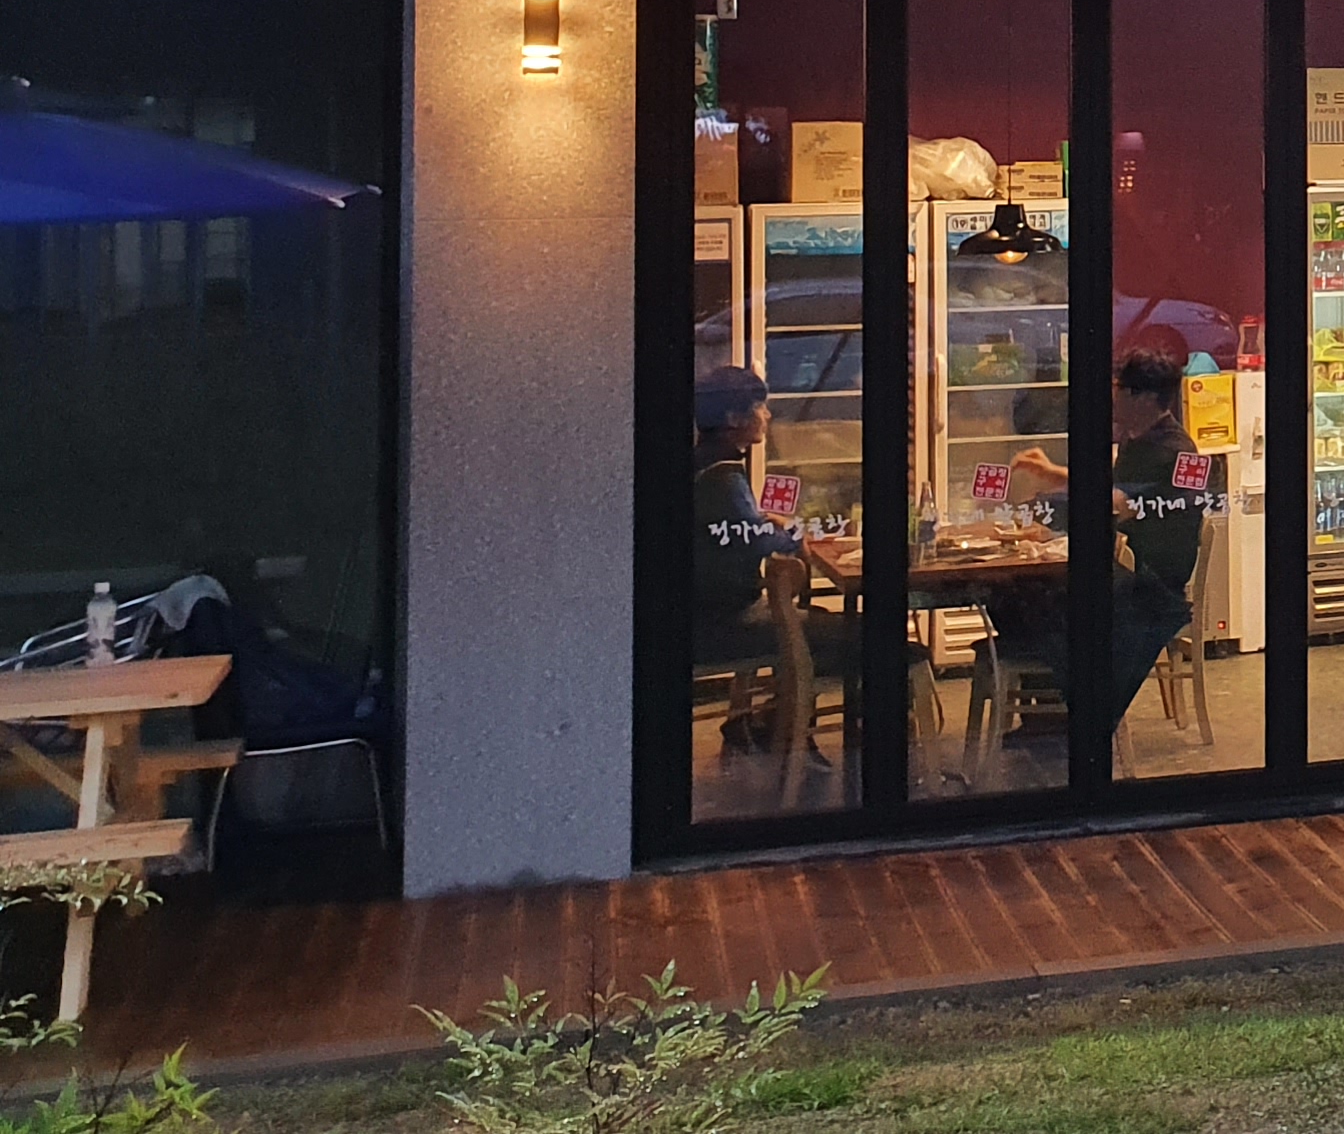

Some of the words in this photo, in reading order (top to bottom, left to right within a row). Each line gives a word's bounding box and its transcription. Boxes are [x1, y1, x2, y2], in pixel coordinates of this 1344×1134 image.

[1126, 495, 1186, 520] 정가네
[708, 519, 775, 546] 정가네
[783, 514, 851, 542] 양곱창
